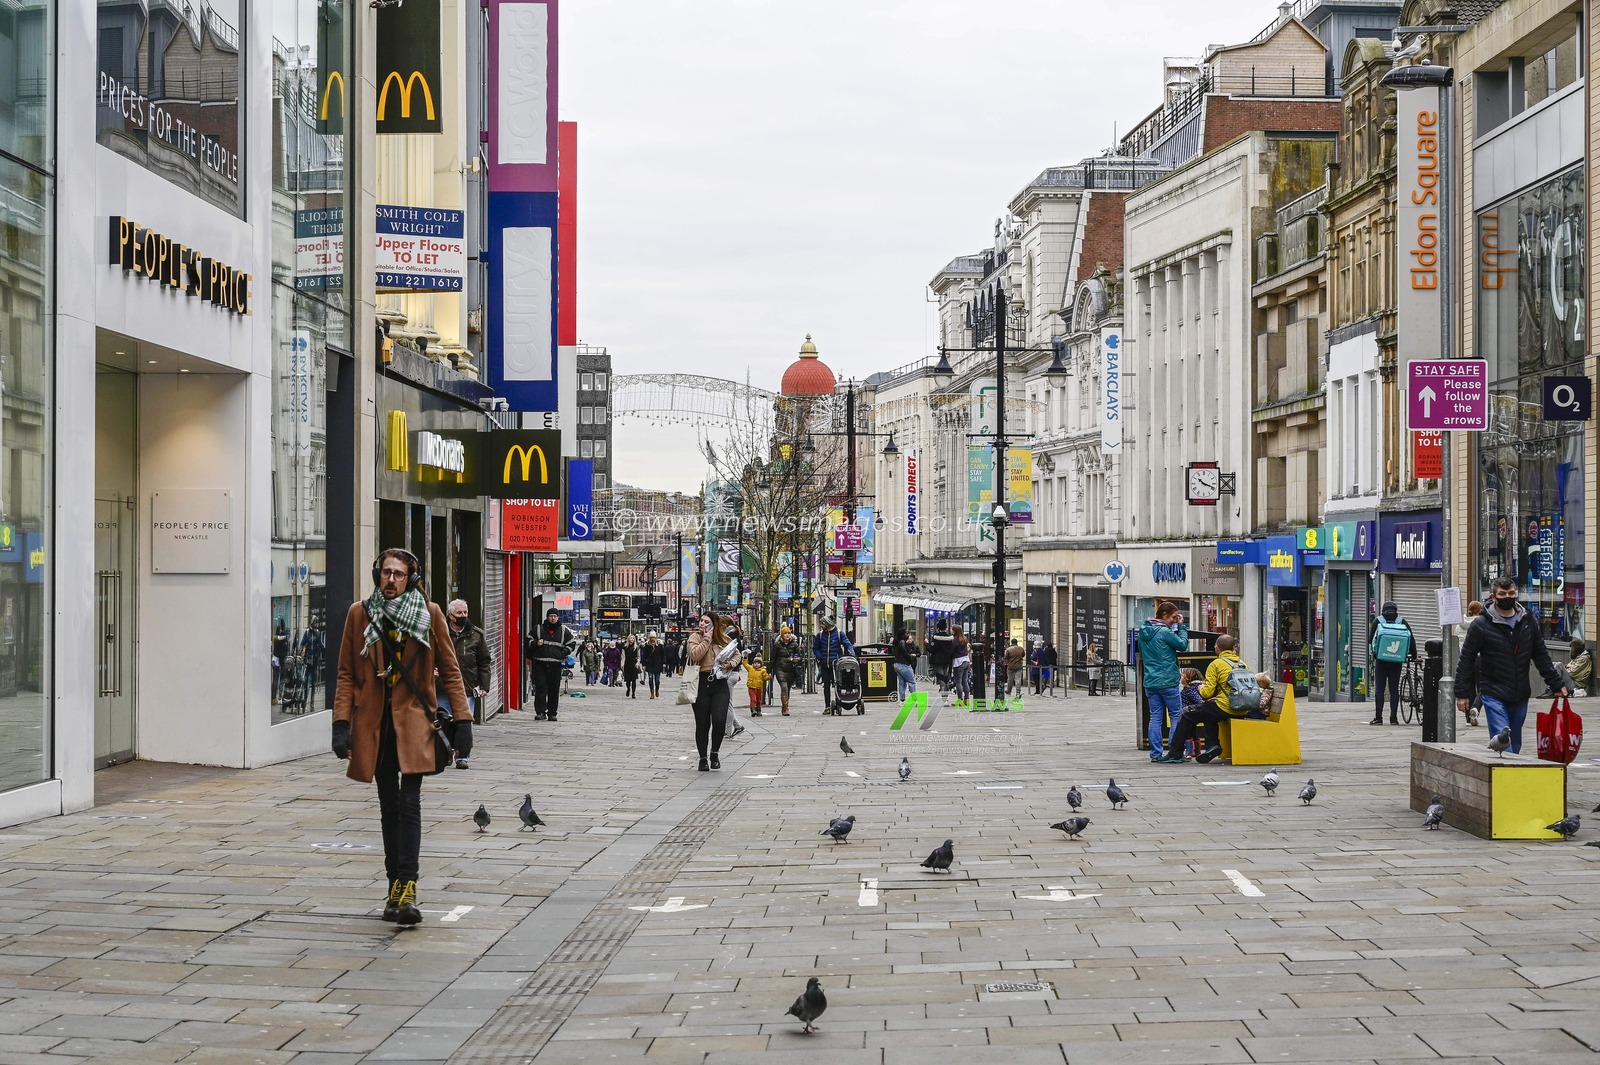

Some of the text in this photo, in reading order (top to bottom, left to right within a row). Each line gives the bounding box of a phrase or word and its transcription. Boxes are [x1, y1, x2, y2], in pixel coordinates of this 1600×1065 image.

[100, 71, 238, 182] PRICES FOR THE PEOPLE
[1410, 110, 1440, 289] Eldon Square
[375, 207, 459, 223] SMITH COLE
[390, 221, 444, 234] WRIGHT
[419, 239, 460, 253] Floors
[393, 251, 439, 265] TO LET
[118, 216, 254, 317] PEOPLE'S PRICE
[405, 276, 426, 286] 221
[431, 277, 460, 288] 1616
[1415, 365, 1480, 376] STAY SAFE
[1106, 352, 1119, 421] BARCLAYS
[1444, 379, 1482, 389] Please
[1444, 391, 1481, 401] follow
[1453, 403, 1472, 413] the
[1443, 417, 1482, 425] arrows
[1418, 438, 1431, 447] TO
[530, 499, 541, 507] TO
[543, 499, 556, 508] LET
[572, 504, 589, 512] WH
[511, 514, 550, 522] ROBINSON
[908, 494, 916, 534] SPORTS
[572, 511, 589, 537] S
[522, 535, 537, 543] 7190
